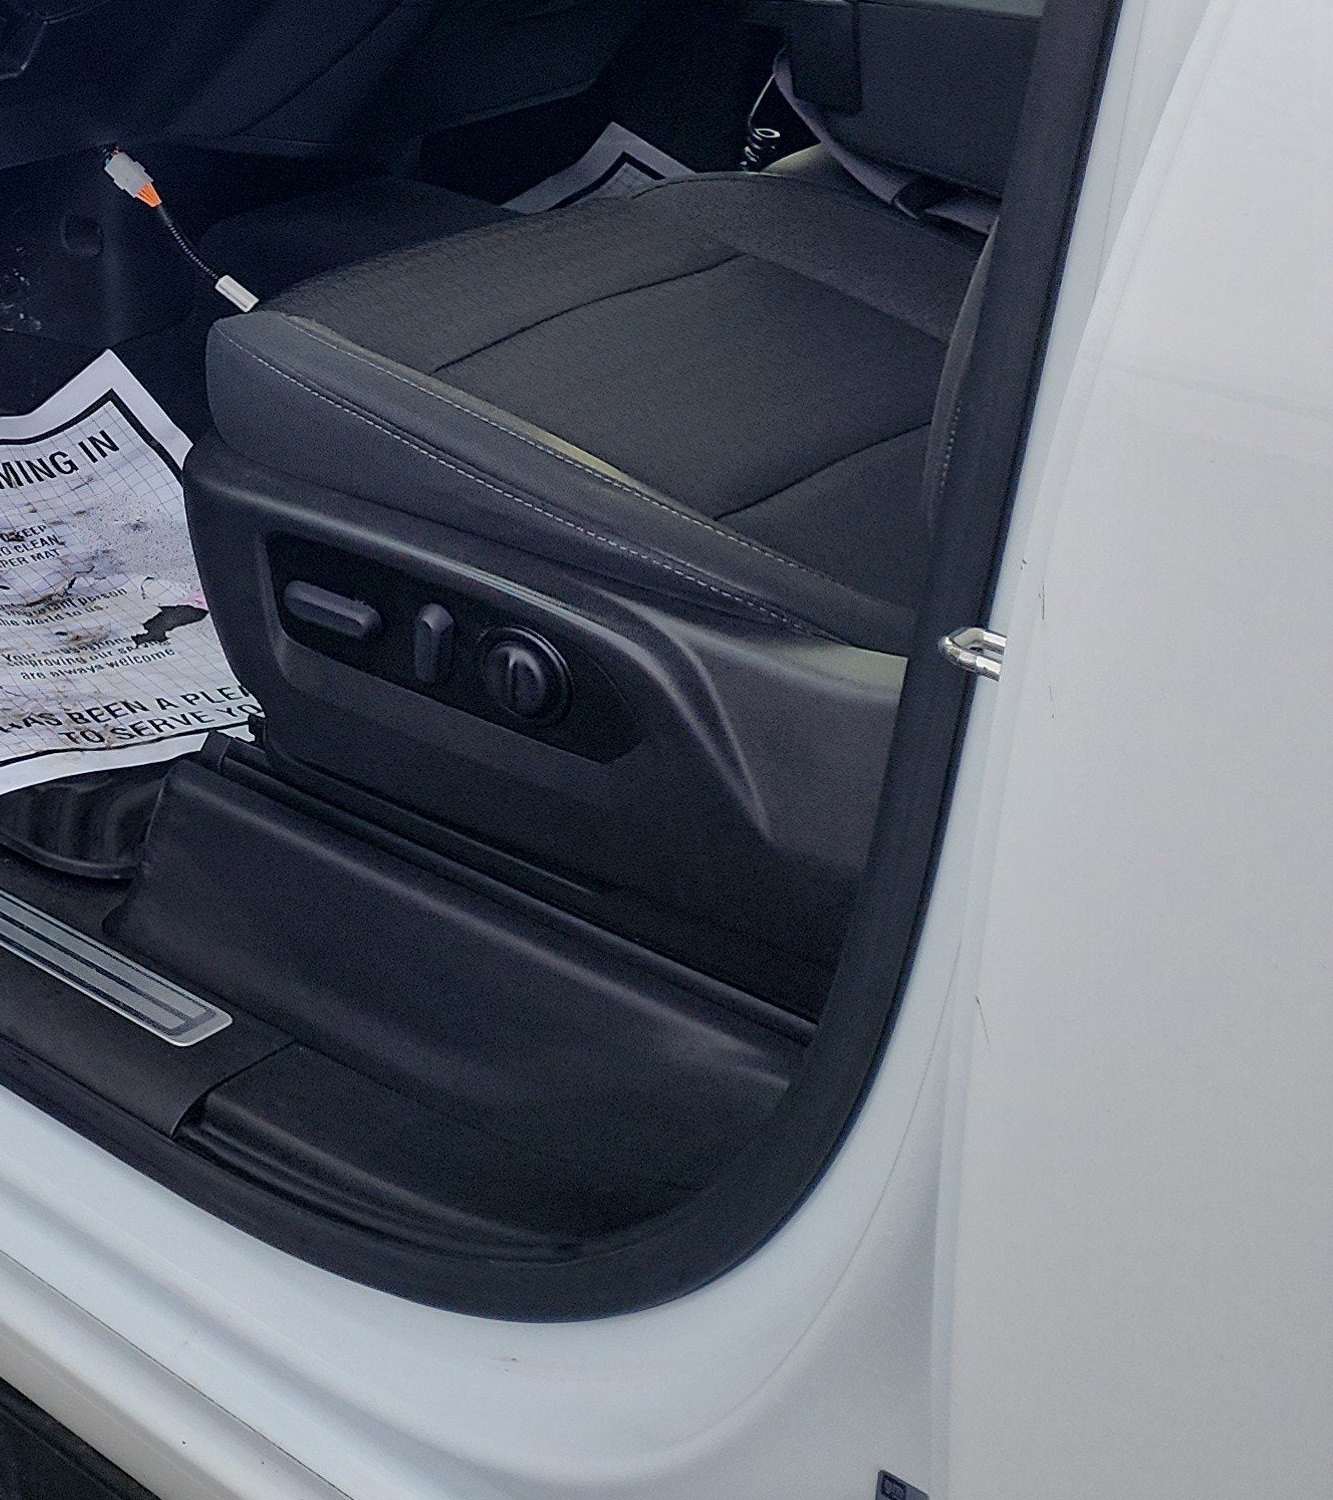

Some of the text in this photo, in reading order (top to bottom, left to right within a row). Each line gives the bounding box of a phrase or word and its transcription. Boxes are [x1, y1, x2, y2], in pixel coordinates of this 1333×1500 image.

[78, 429, 121, 465] IN
[29, 548, 61, 562] MAT
[105, 648, 176, 669] welcome
[64, 699, 150, 726] BEEN
[155, 697, 181, 713] A
[56, 729, 105, 746] TO
[109, 709, 216, 741] SERVE
